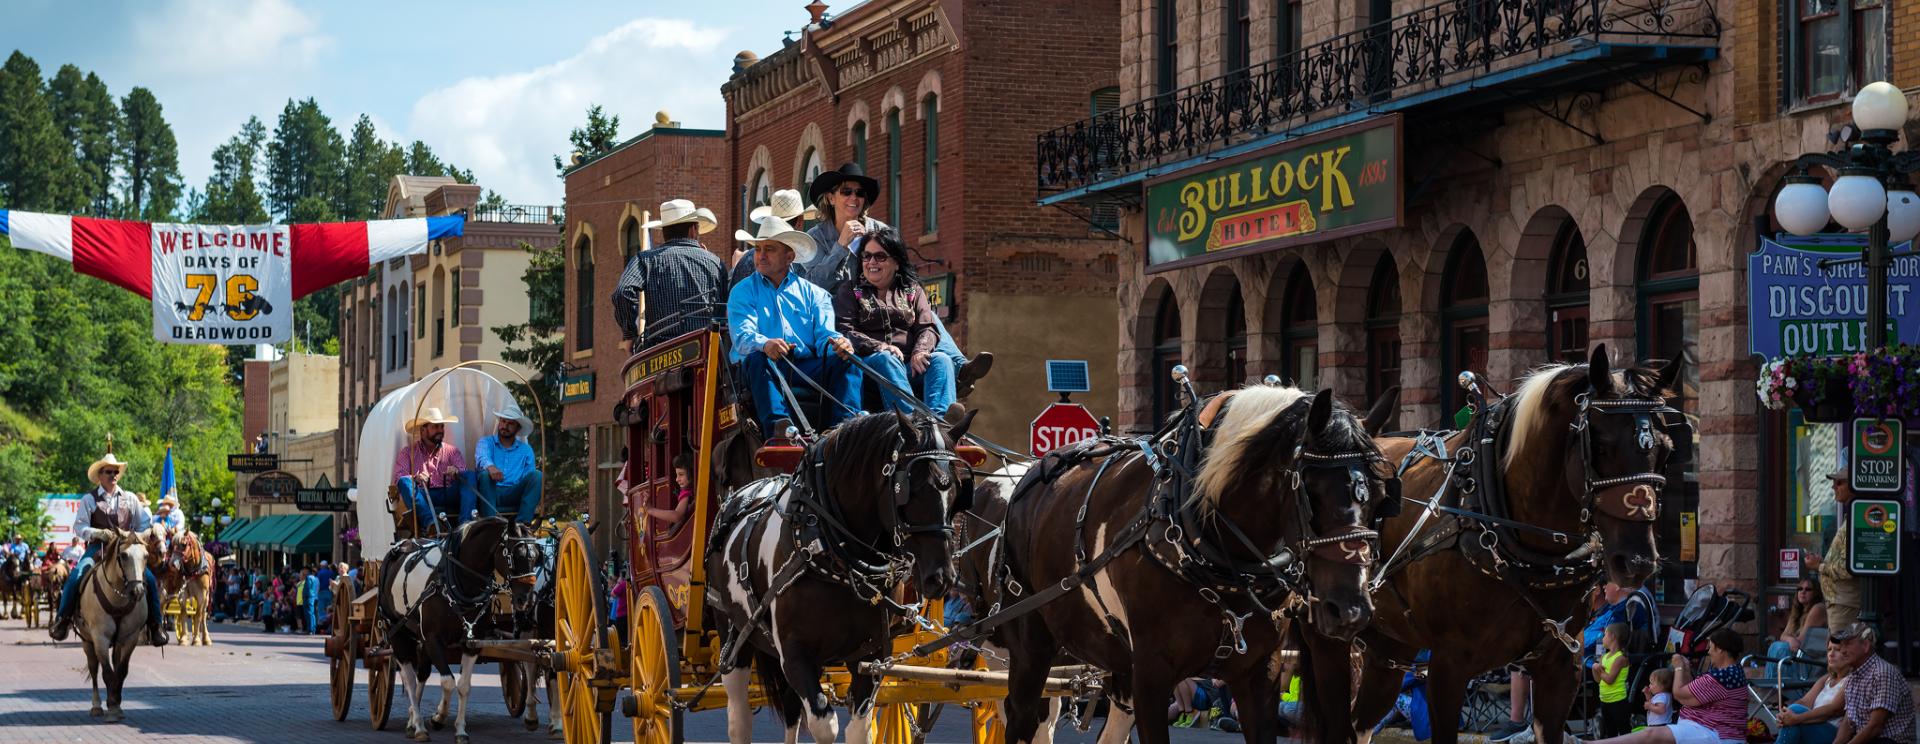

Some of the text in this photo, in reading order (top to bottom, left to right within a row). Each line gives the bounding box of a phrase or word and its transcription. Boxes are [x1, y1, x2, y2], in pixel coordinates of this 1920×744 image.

[1359, 158, 1388, 187] 1895
[1178, 146, 1355, 242] BULLOCK
[1223, 210, 1297, 241] HOTEL
[159, 231, 284, 257] WELCOME
[184, 255, 259, 269] DAYS OF
[1574, 258, 1588, 281] 6
[1762, 252, 1920, 278] PAM'S URPL OOR
[185, 273, 259, 321] 76
[1768, 284, 1911, 318] DISCOUT
[172, 325, 273, 340] DEADWOOD
[1783, 321, 1894, 355] OUTLE
[649, 347, 683, 374] EXPRESS
[1856, 474, 1897, 483] NO PARKING
[1860, 460, 1894, 475] STOP
